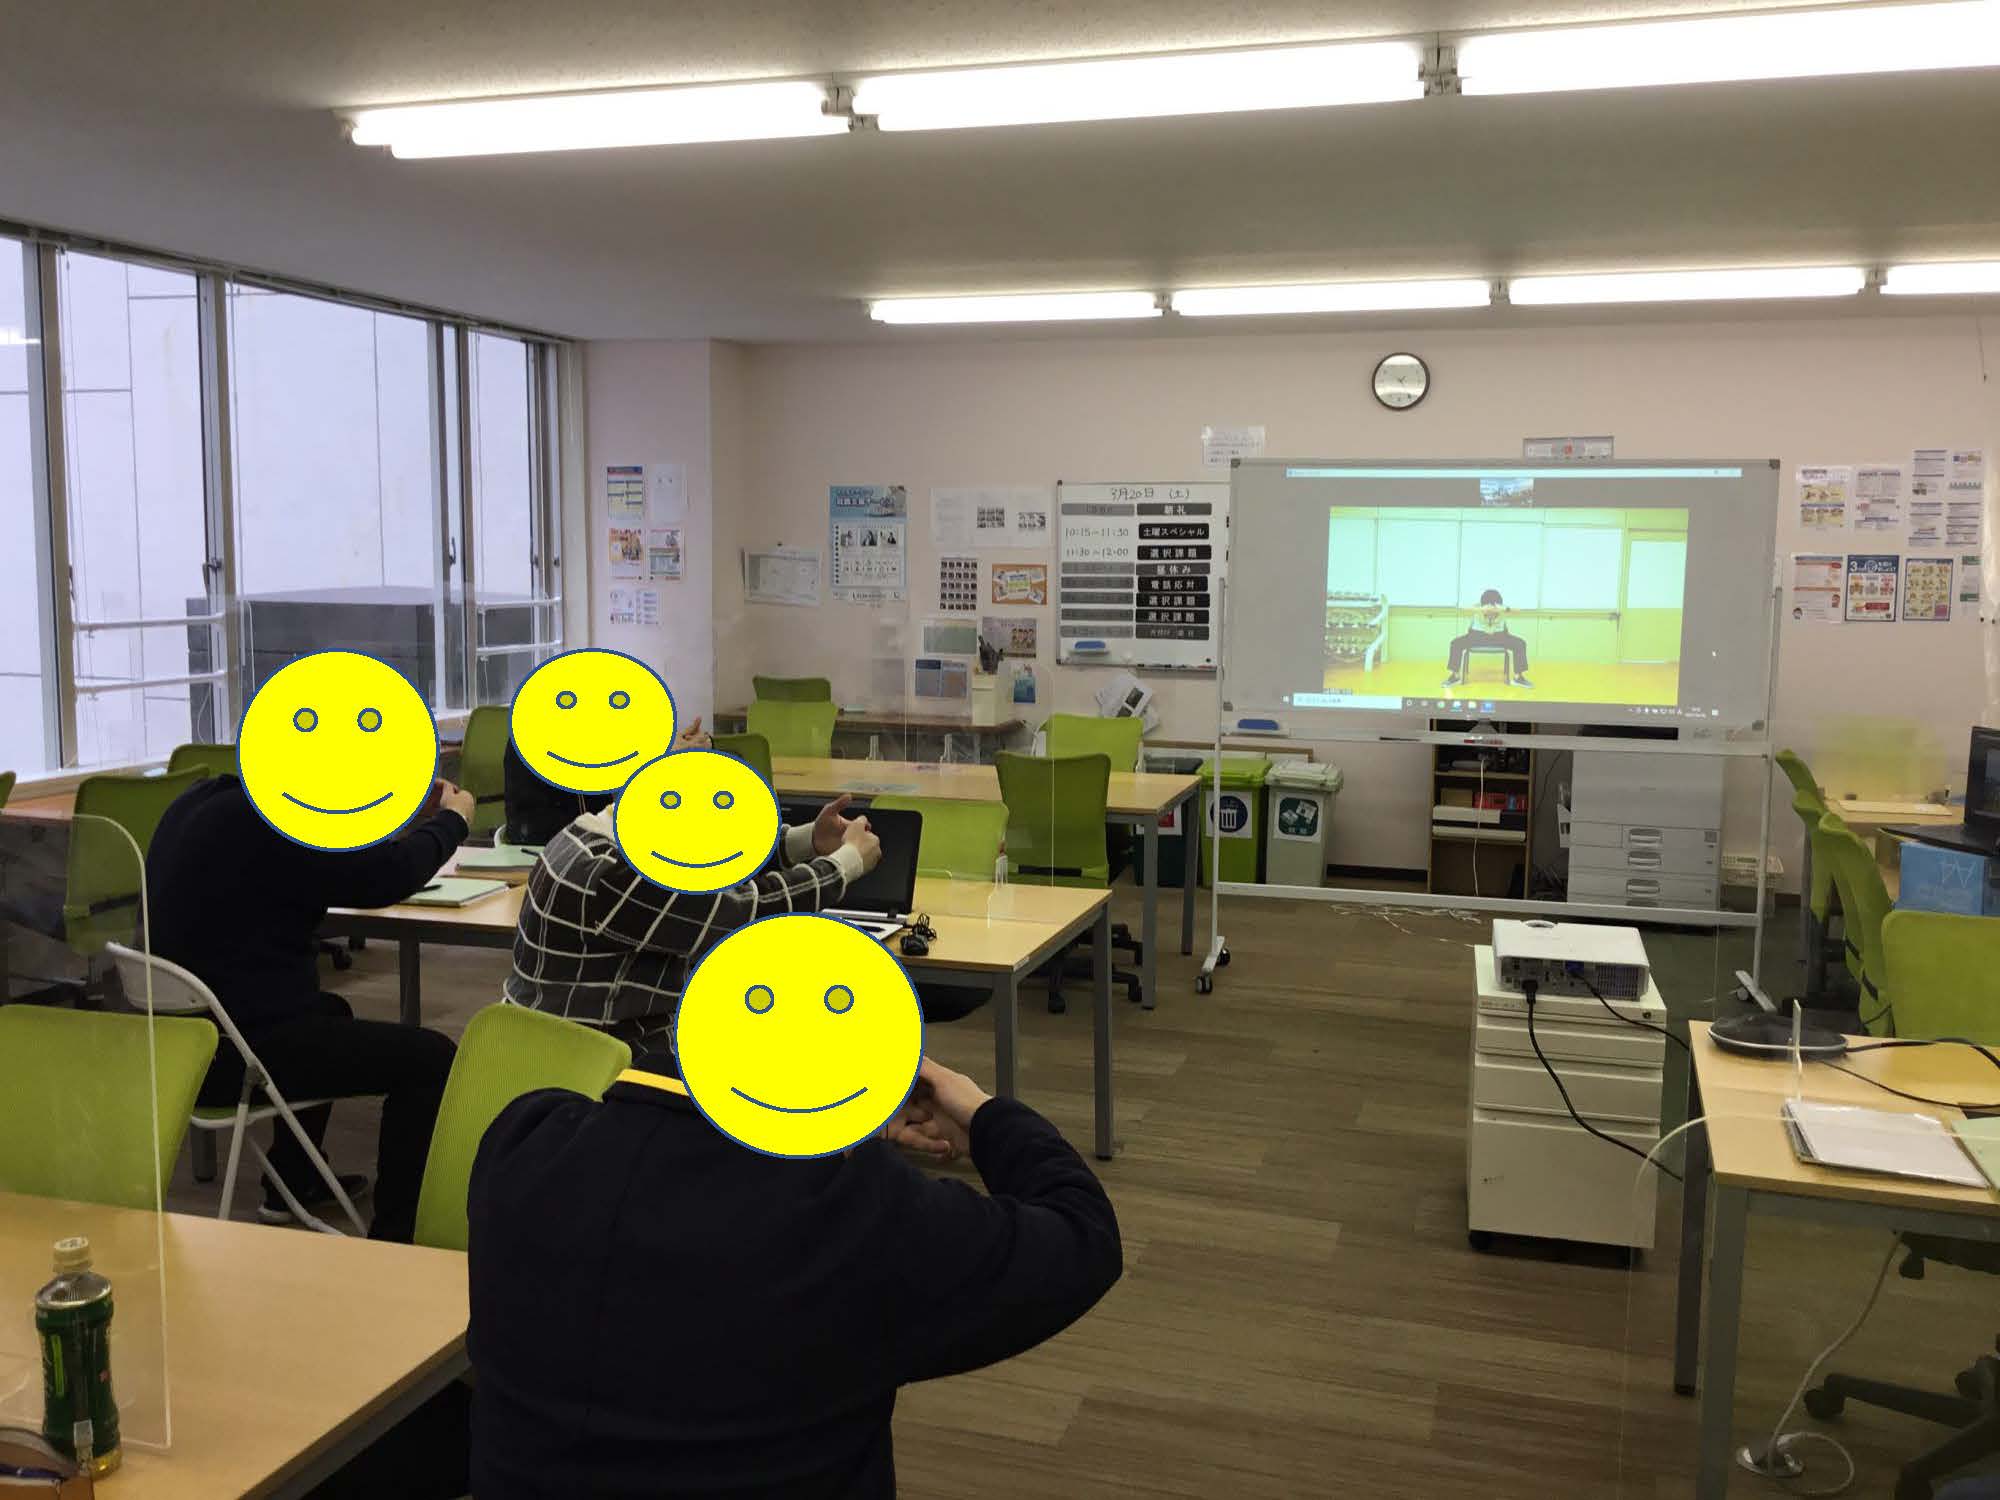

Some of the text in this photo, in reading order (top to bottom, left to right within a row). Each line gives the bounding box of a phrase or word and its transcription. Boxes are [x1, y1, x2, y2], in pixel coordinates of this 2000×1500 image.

[1143, 527, 1205, 537] 土曜スペシャル
